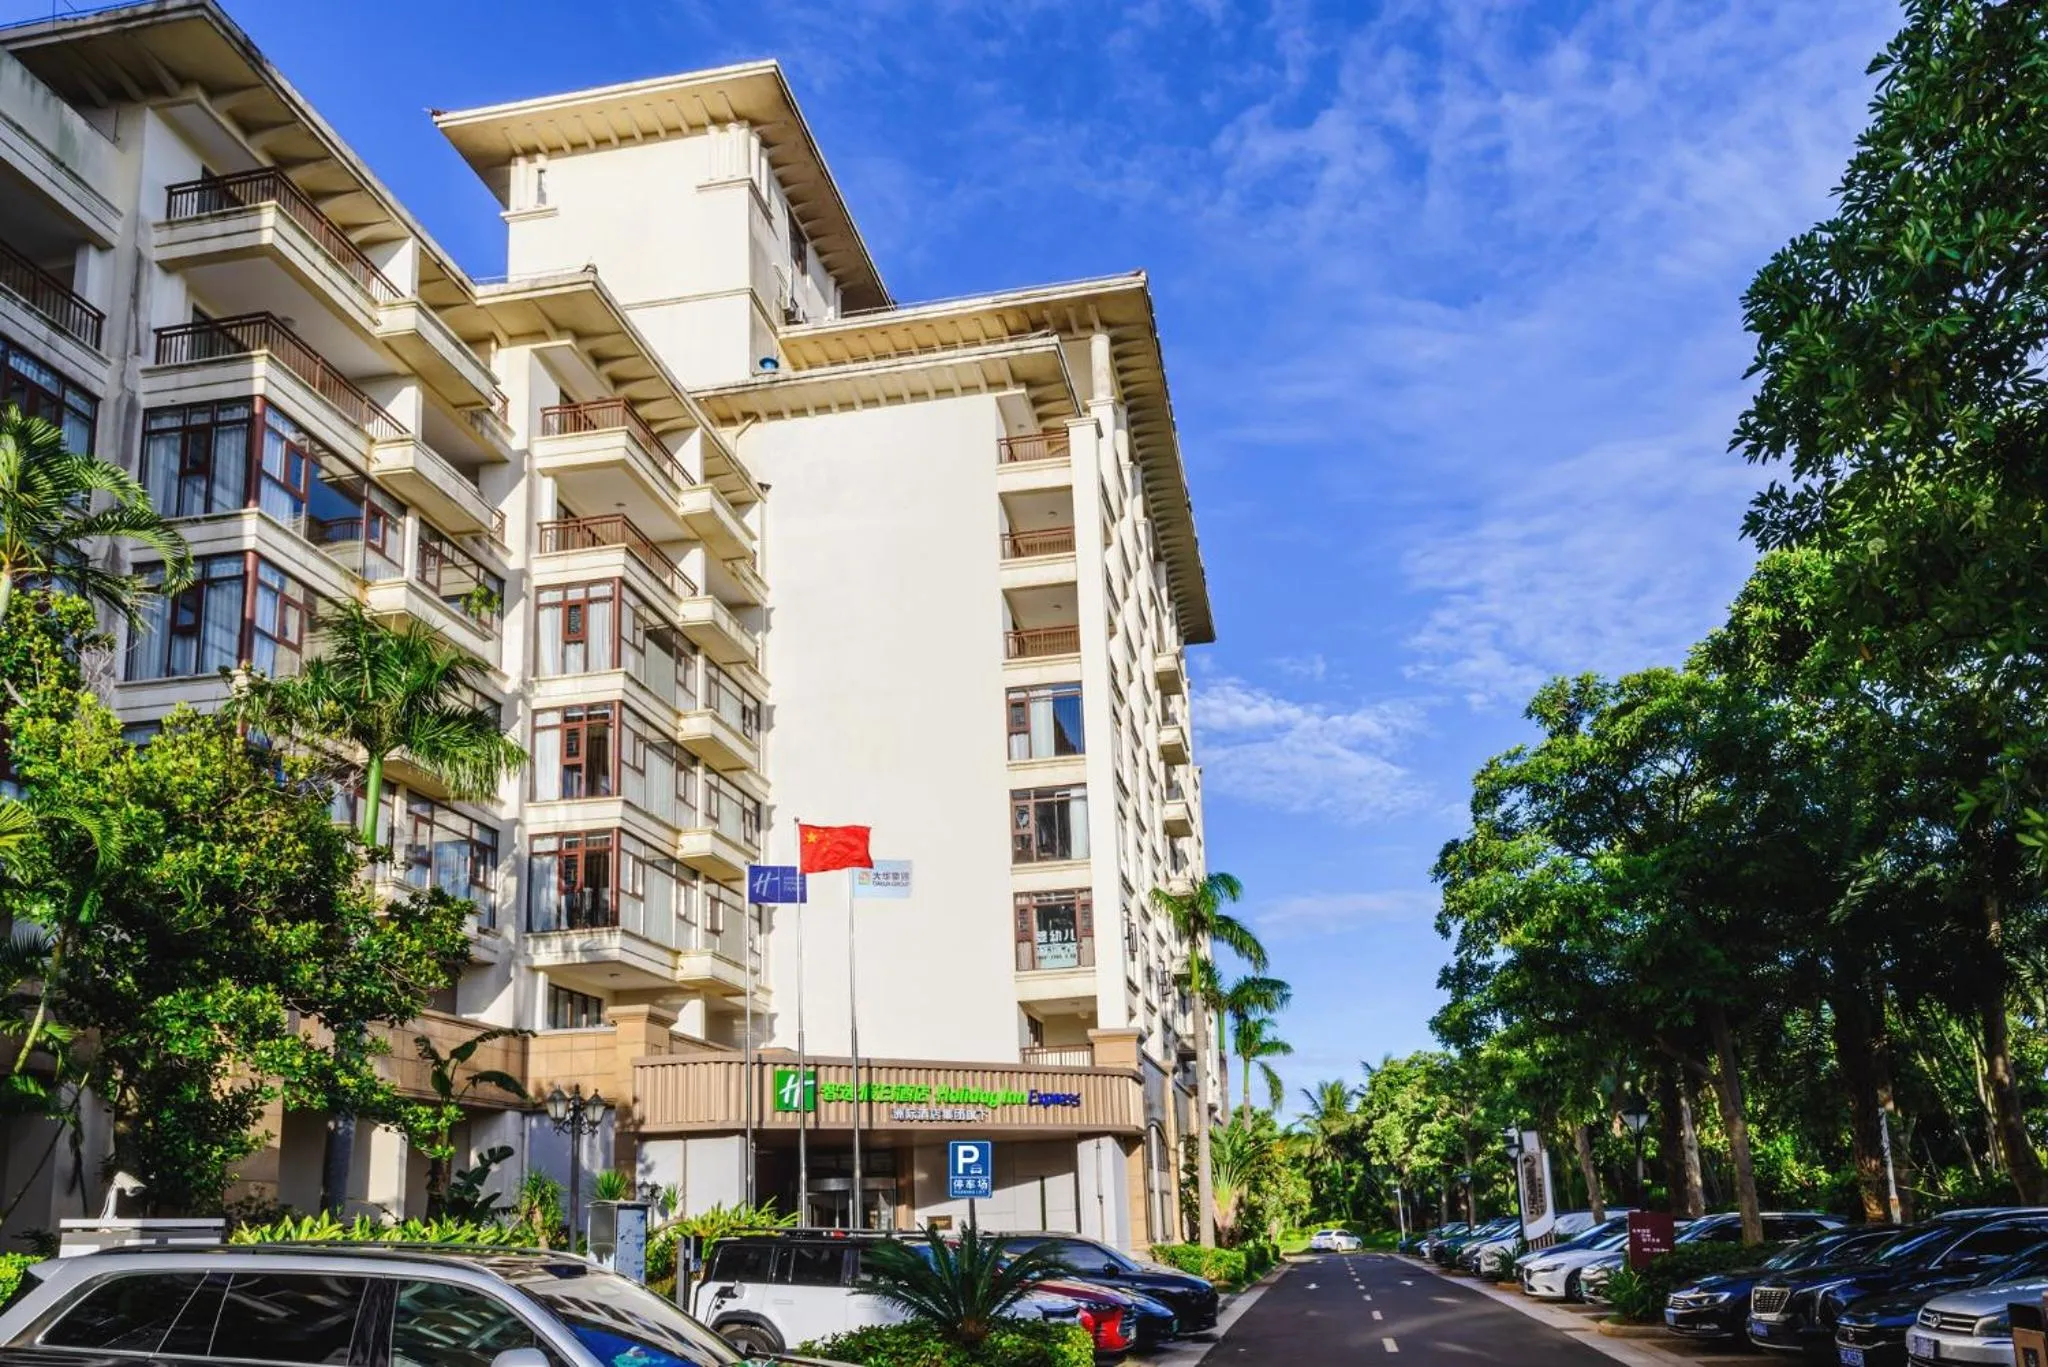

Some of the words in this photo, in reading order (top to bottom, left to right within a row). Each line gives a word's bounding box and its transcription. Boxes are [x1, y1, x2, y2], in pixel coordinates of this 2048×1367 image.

[936, 1084, 998, 1109] Holiday
[1000, 1087, 1027, 1106] Inn
[1028, 1089, 1081, 1109] Express
[957, 1145, 980, 1174] P
[953, 1178, 988, 1190] 停车场
